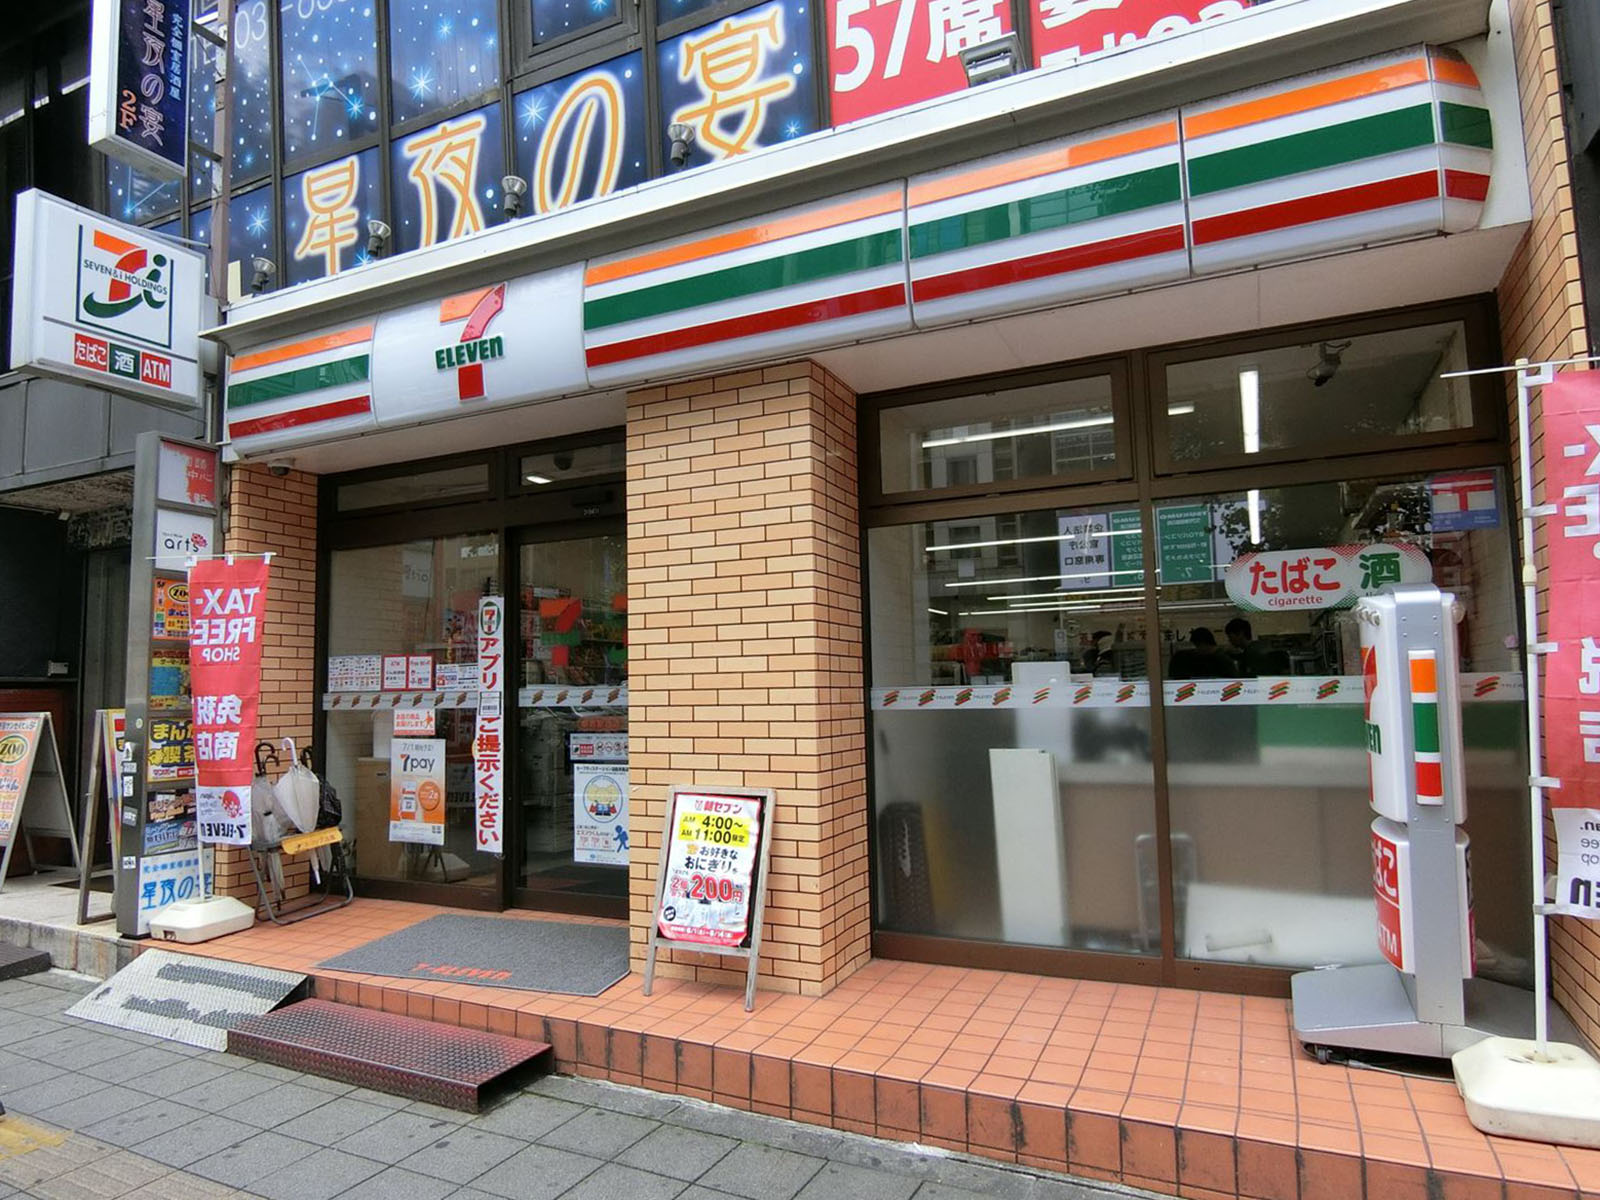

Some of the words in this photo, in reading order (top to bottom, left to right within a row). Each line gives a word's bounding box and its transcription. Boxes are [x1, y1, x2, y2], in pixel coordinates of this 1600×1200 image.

[124, 273, 168, 296] HOLDINGS
[75, 340, 107, 366] たばこ
[114, 350, 134, 373] 酒
[143, 359, 170, 382] ATM
[164, 538, 200, 552] arts
[1249, 556, 1341, 596] たばこ
[1359, 551, 1401, 589] 酒
[1268, 594, 1324, 607] cigarette
[479, 637, 501, 690] アプリ
[400, 754, 435, 772] 7pay
[476, 716, 502, 845] ご提示ください
[699, 846, 738, 860] お好きな
